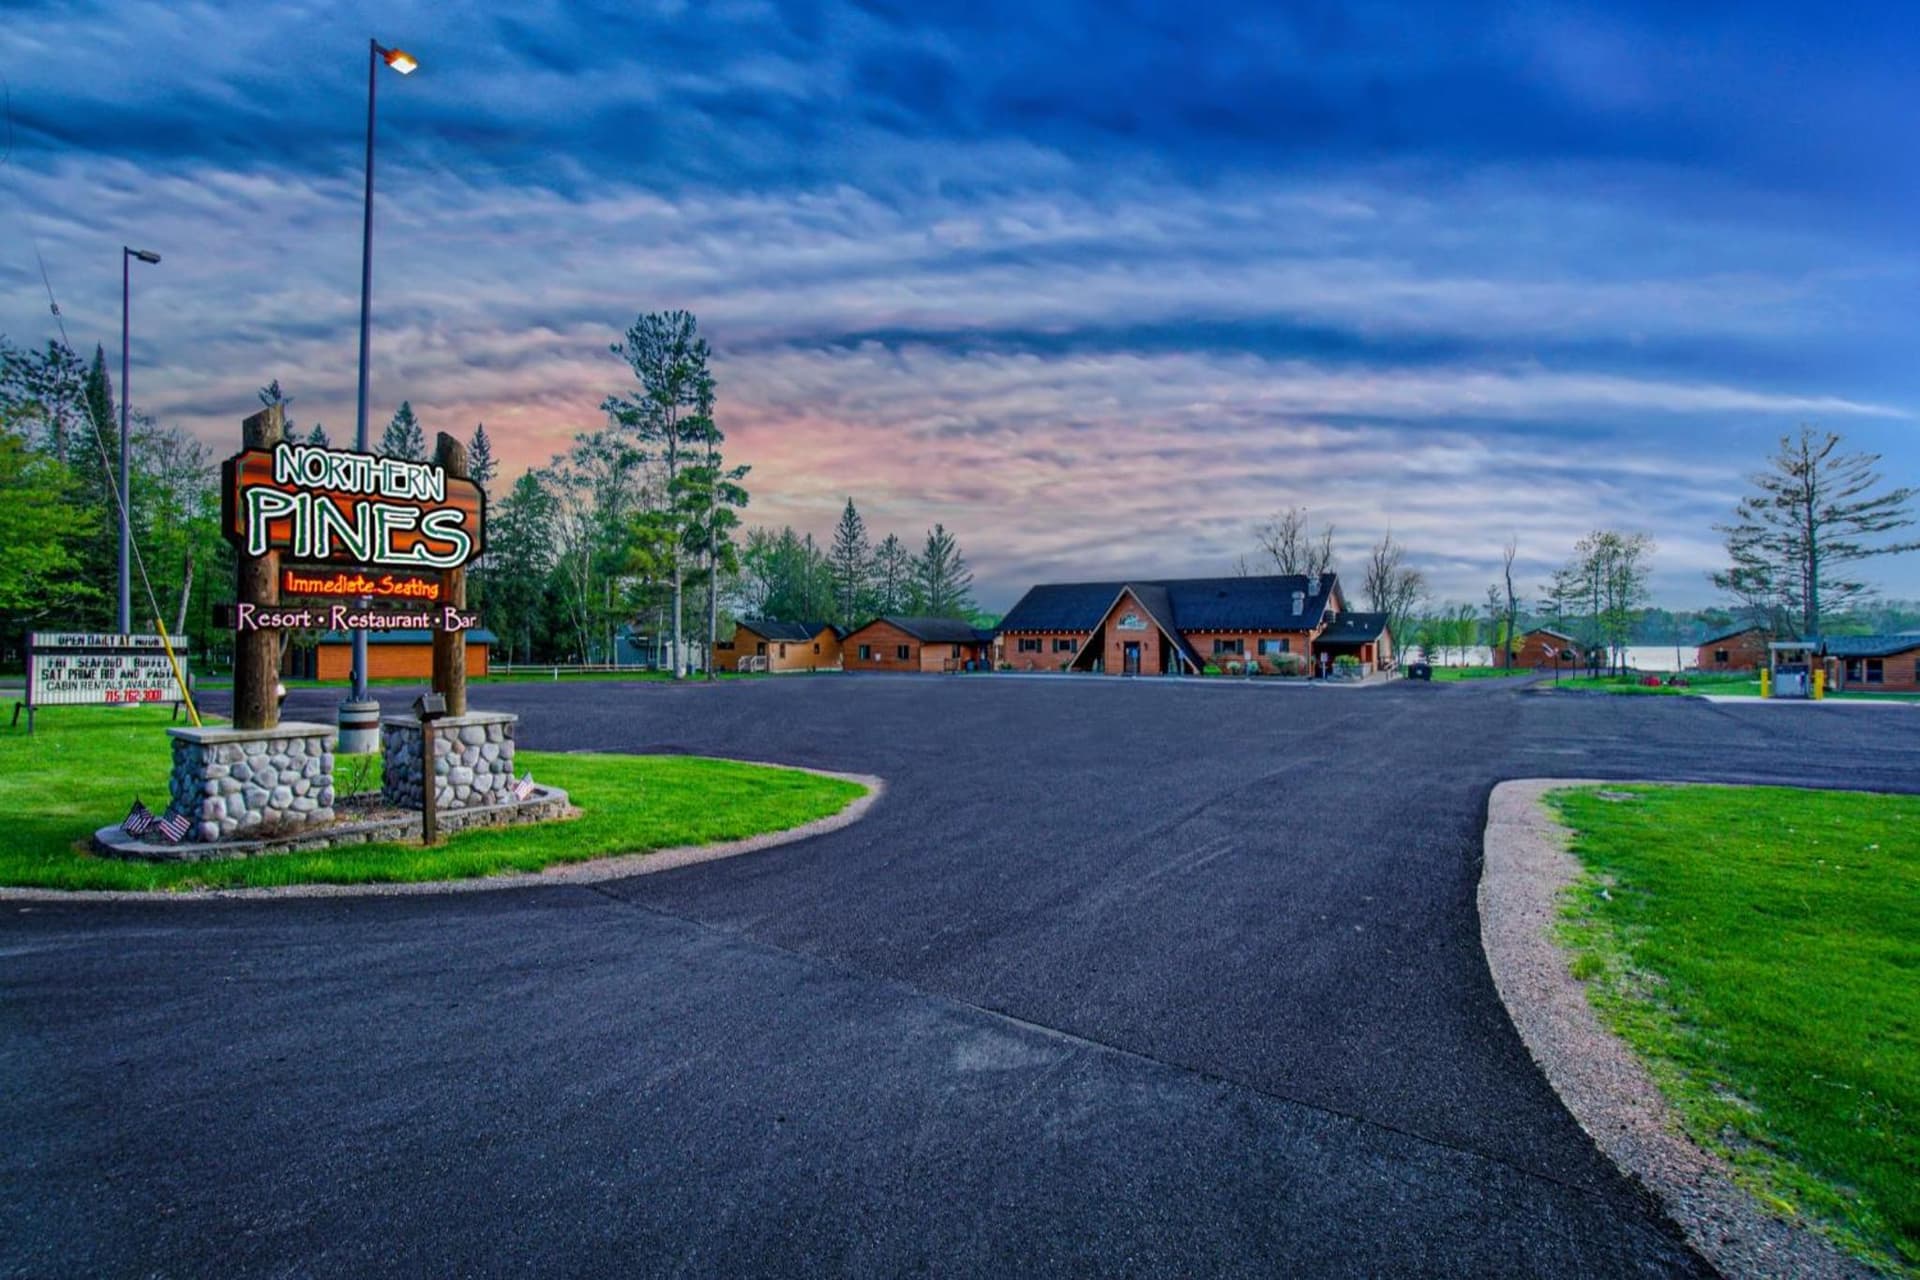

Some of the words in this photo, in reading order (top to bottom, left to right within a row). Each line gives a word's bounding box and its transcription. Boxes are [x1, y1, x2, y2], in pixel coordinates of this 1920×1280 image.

[276, 444, 444, 501] NORTHERN
[247, 488, 471, 568] PINES
[287, 572, 375, 594] Immediate
[377, 575, 440, 599] Seating
[238, 603, 312, 630] Resort
[330, 605, 430, 631] Restaurant
[444, 608, 478, 631] Bar
[58, 636, 85, 646] OPEN
[41, 669, 62, 680] SAT
[68, 669, 97, 680] PRIME
[120, 669, 140, 679] AND
[46, 680, 78, 691] CABIN
[80, 680, 123, 690] RENTALS
[126, 679, 173, 689] AVAILABLE
